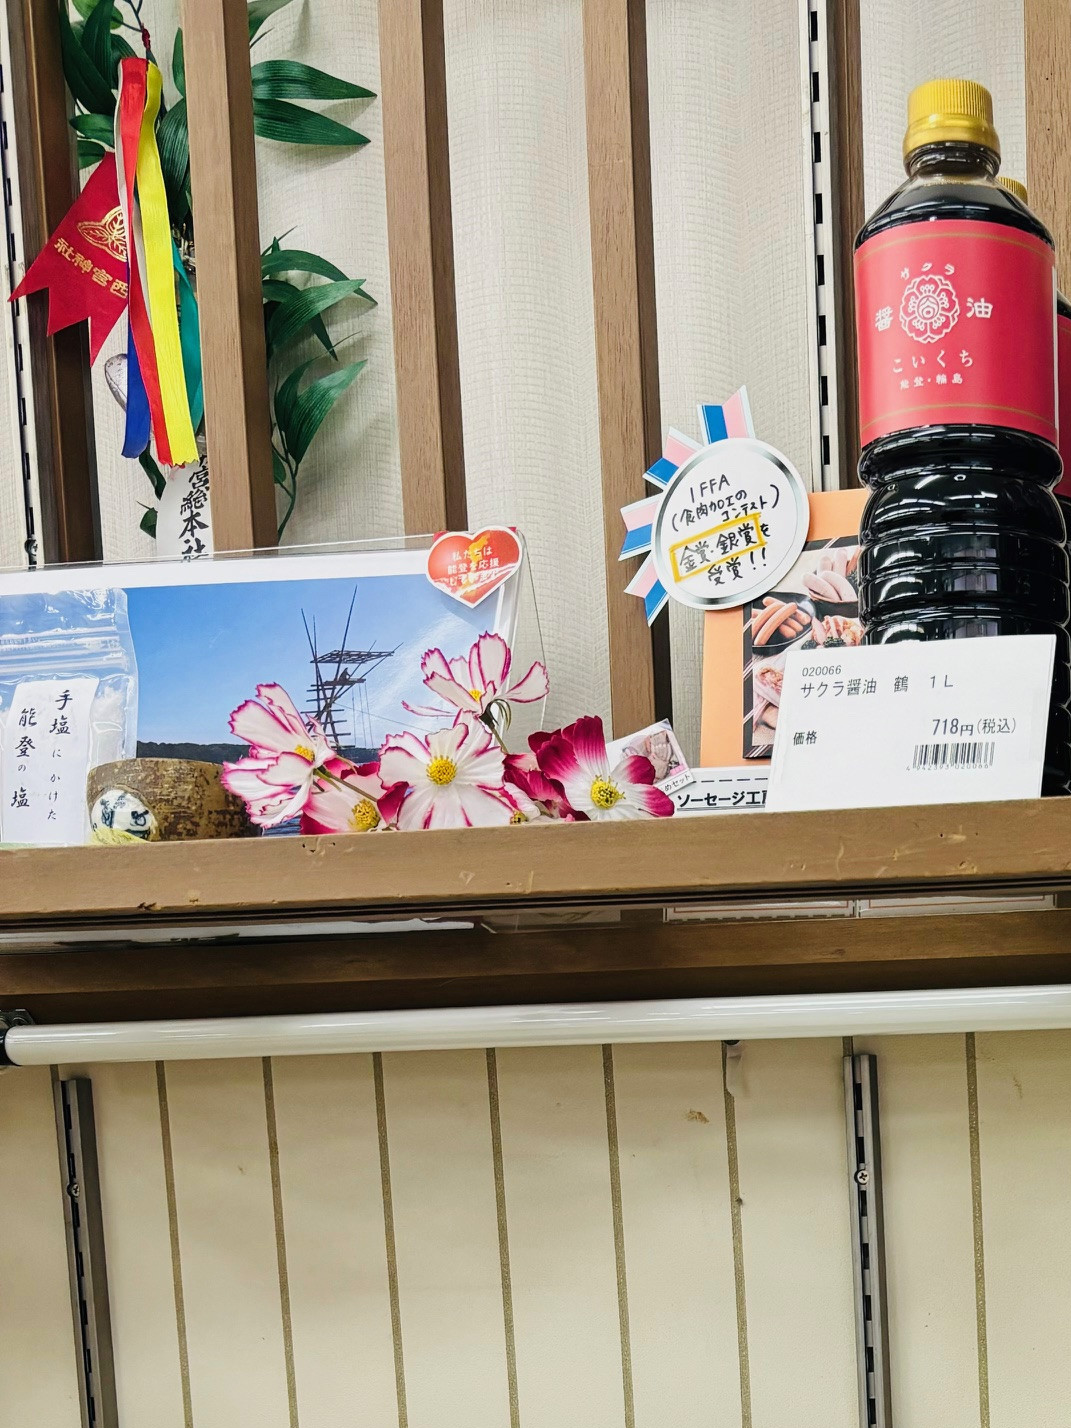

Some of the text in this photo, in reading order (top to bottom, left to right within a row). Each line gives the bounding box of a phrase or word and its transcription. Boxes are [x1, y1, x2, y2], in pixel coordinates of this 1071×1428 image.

[893, 350, 973, 373] こいくち
[900, 373, 963, 389] 能登・輪島
[690, 474, 731, 503] IFFA
[671, 490, 747, 532] (食肉加工の
[447, 557, 500, 575] 能登を応援
[802, 665, 842, 677] 020066
[801, 678, 877, 699] サクラ醤油
[893, 675, 909, 692] 鶴
[793, 731, 818, 746] 価格
[932, 717, 1017, 737] 718円(税込)
[11, 708, 38, 808] 能登の塩
[47, 689, 73, 821] 手塩にかけた
